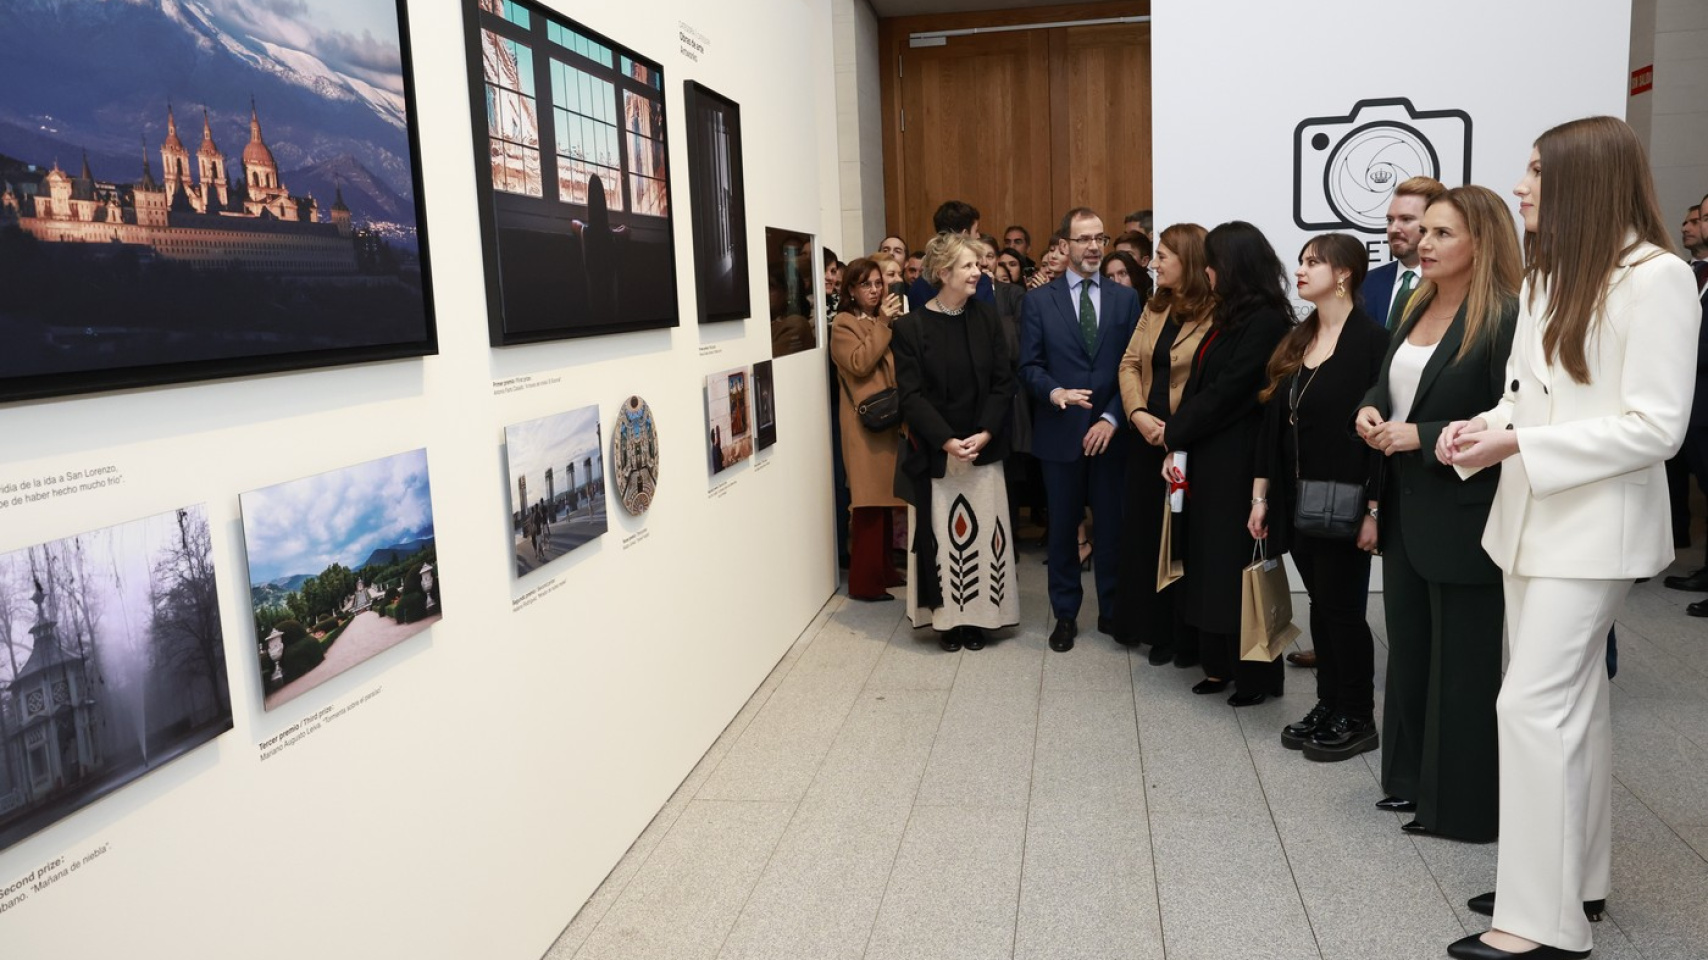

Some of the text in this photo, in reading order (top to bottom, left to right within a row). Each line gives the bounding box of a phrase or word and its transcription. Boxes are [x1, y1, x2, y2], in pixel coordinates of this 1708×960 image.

[20, 480, 31, 490] de
[33, 478, 42, 488] la
[43, 476, 57, 486] ida
[59, 475, 65, 483] a
[66, 471, 83, 481] San
[84, 465, 118, 478] Lorenzo,
[11, 496, 23, 506] de
[24, 491, 50, 503] haber
[52, 485, 78, 497] hecho
[79, 479, 106, 492] mucho
[259, 735, 278, 751] Tercer
[279, 723, 299, 742] premio
[303, 712, 318, 726] Third
[259, 743, 283, 762] Mariano
[0, 855, 65, 899] Second prize:
[70, 860, 81, 872] de
